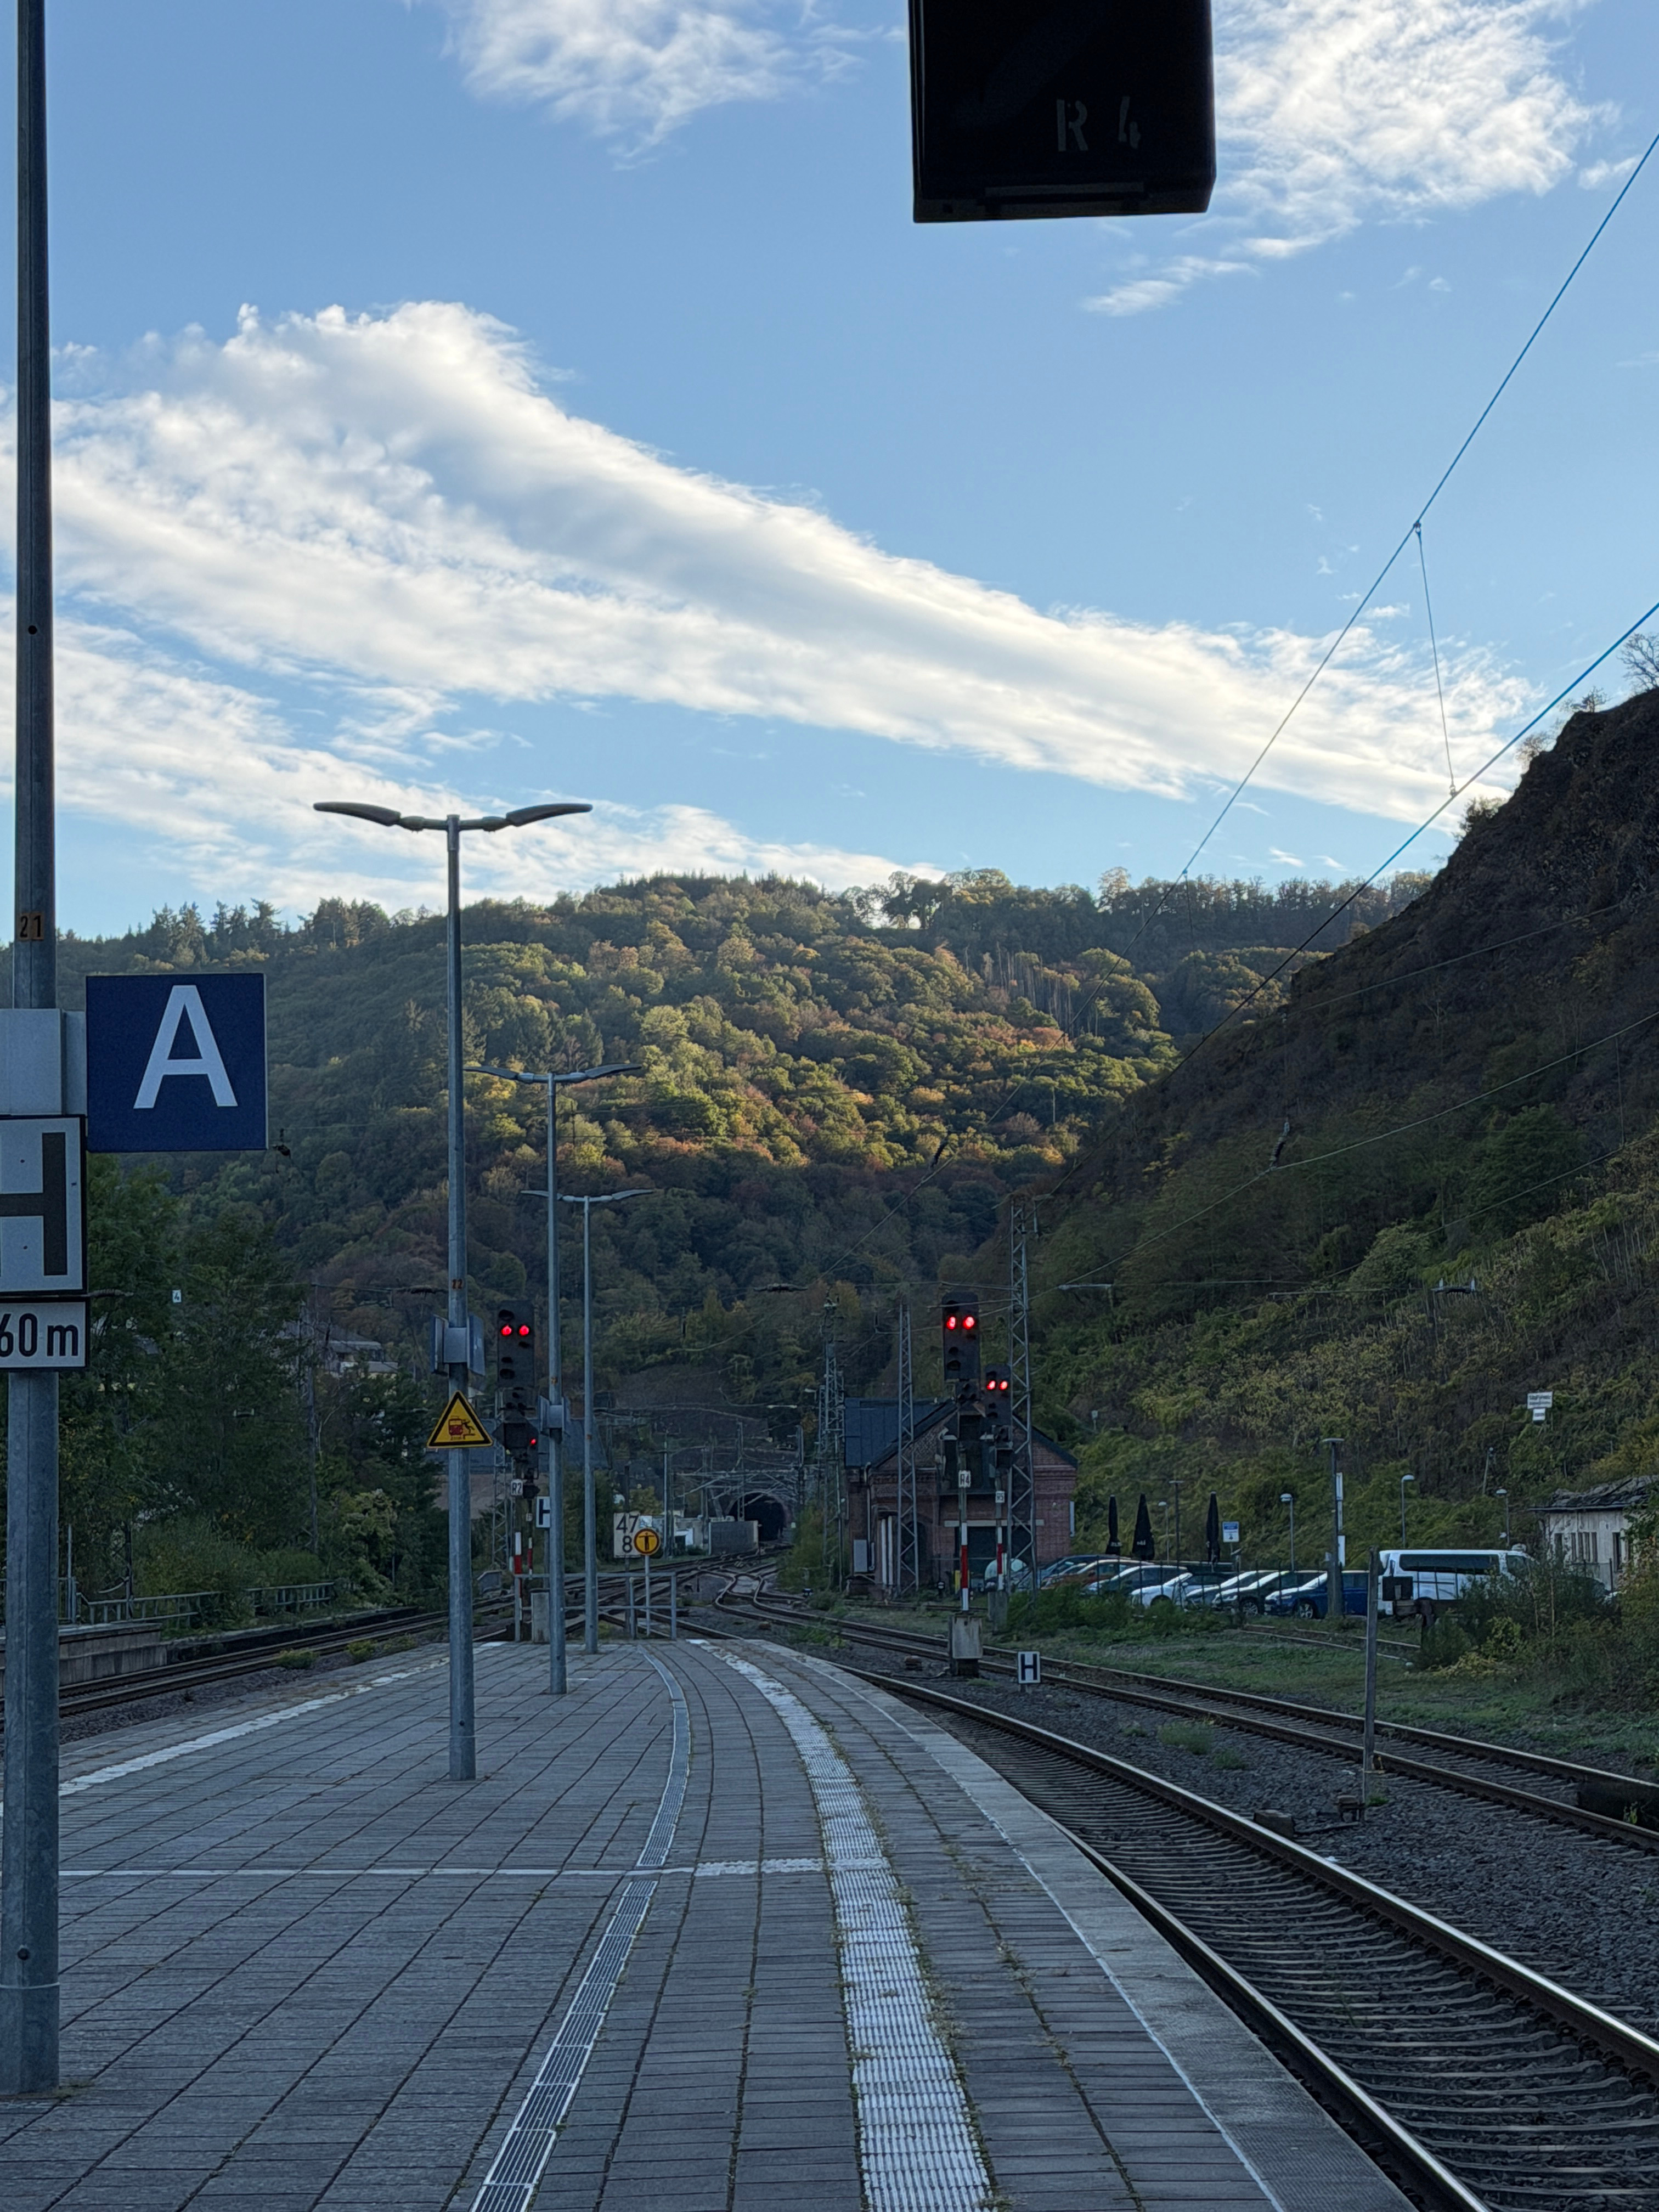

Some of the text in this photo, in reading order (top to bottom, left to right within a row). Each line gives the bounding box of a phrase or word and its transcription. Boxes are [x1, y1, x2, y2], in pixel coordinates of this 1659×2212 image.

[1057, 99, 1088, 152] R
[20, 915, 41, 938] 21
[133, 985, 238, 1109] A
[0, 1132, 67, 1276] H
[47, 1324, 78, 1357] m
[616, 1515, 639, 1533] 47
[622, 1535, 633, 1553] 8
[1020, 1654, 1037, 1681] H
